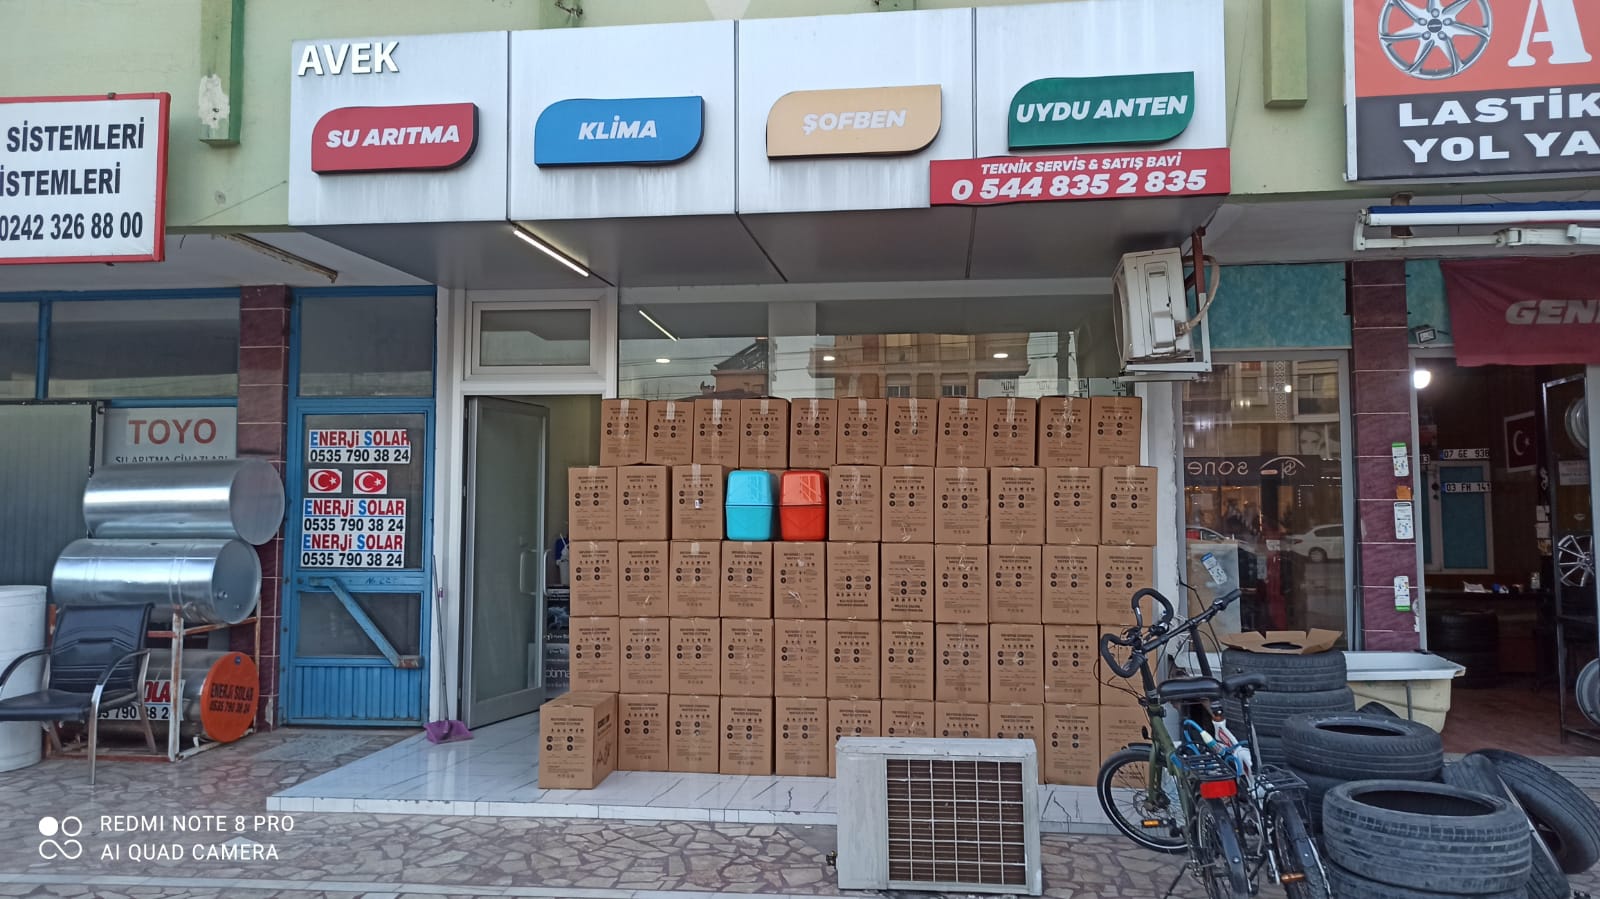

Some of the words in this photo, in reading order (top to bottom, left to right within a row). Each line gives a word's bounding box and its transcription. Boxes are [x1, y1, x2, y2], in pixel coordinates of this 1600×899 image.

[297, 41, 400, 76] AVEK
[1016, 100, 1091, 123] UYDU
[1094, 95, 1188, 119] ANTEN
[6, 117, 145, 152] SİSTEMLERİ
[577, 115, 657, 140] KLİMA
[802, 110, 908, 134] ŞOFBEN
[326, 129, 360, 148] SU
[362, 125, 460, 147] ARITMA
[1403, 135, 1510, 163] YOL
[981, 158, 1034, 175] TEKNİK
[1035, 156, 1086, 172] SERVİS
[1088, 159, 1098, 170] &
[1102, 157, 1143, 171] SATIŞ
[1146, 152, 1183, 168] BAYİ
[0, 161, 121, 197] İSTEMLERİ
[951, 179, 974, 201] 0
[979, 176, 1043, 199] 544
[1049, 173, 1110, 196] 835
[1116, 172, 1139, 194] 2
[1144, 169, 1207, 192] 835
[0, 214, 44, 241] 0242
[50, 213, 85, 240] 326
[91, 212, 114, 239] 88
[120, 211, 143, 239] 00
[1505, 299, 1600, 326] GEN
[128, 418, 217, 445] TOYO
[364, 430, 410, 446] SOLAR
[310, 449, 342, 462] 0535
[346, 449, 370, 462] 790
[374, 449, 389, 462] 38
[394, 449, 410, 462] 24
[358, 499, 404, 515] SOLAR
[304, 518, 336, 531] 0535
[340, 518, 364, 531] 790
[368, 518, 384, 531] 38
[388, 518, 404, 531] 24
[357, 534, 403, 550] SOLAR
[302, 552, 334, 566] 0535
[338, 552, 362, 566] 790
[366, 552, 382, 566] 38
[386, 552, 403, 566] 24
